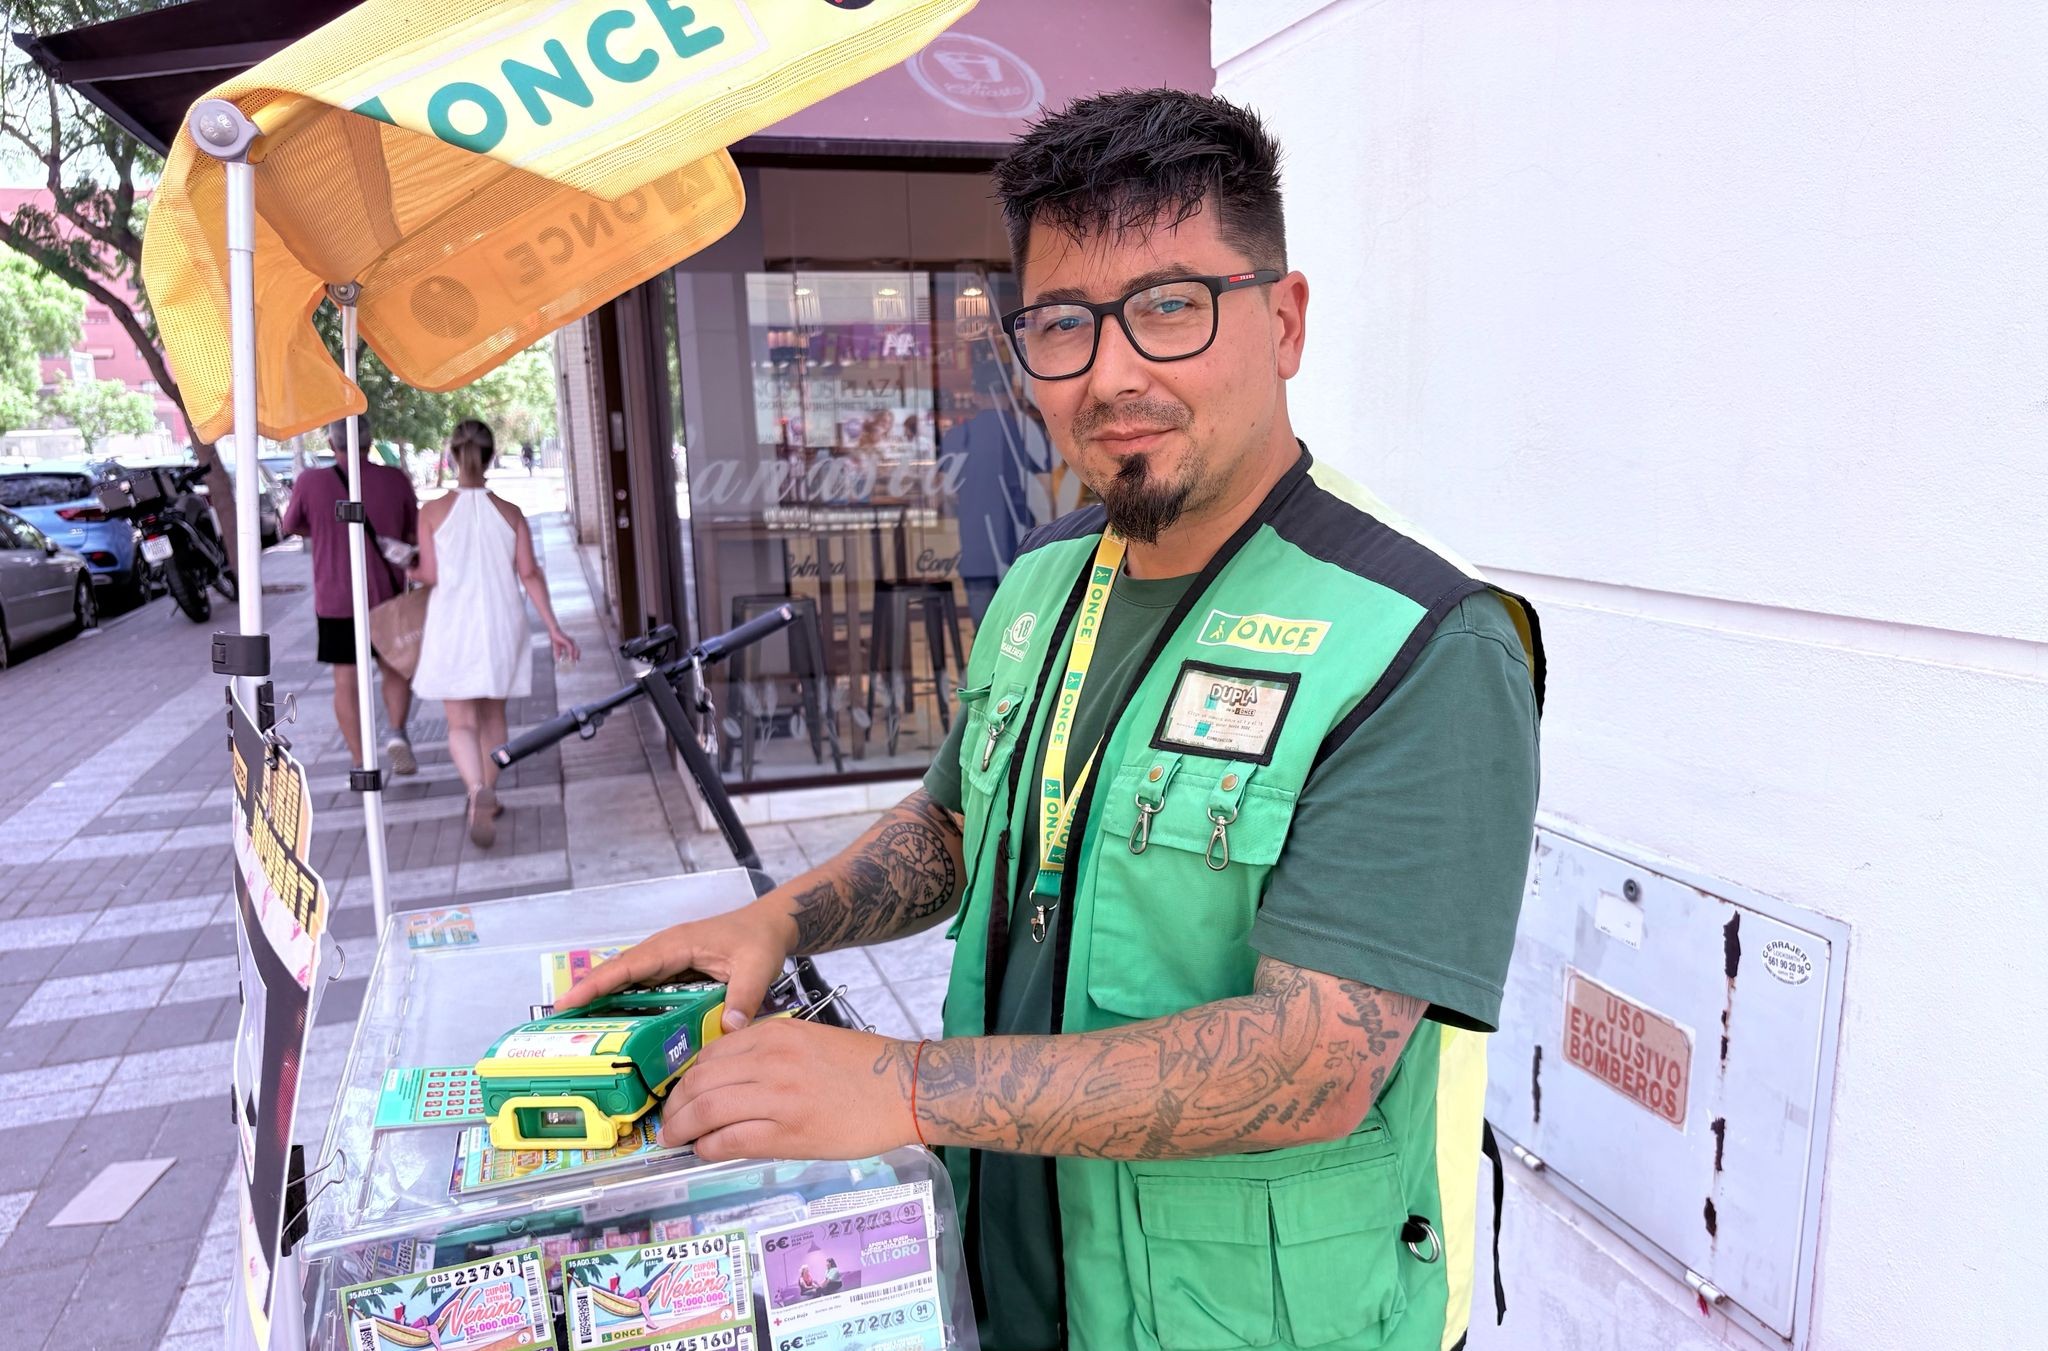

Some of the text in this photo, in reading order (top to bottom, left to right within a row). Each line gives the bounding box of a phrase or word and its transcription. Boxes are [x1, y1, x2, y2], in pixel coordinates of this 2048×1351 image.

[427, 0, 725, 153] ONCE
[1079, 588, 1103, 639] ONCE
[1237, 619, 1319, 647] ONCE
[1209, 684, 1257, 706] DUPLA
[1053, 694, 1073, 744] ONCE
[1046, 802, 1059, 849] ONC
[1762, 941, 1811, 971] CERRAJERO
[1606, 997, 1645, 1039] USO
[507, 1047, 545, 1058] Getnet
[1570, 1005, 1681, 1089] EXCLUSIVO
[1570, 1033, 1676, 1118] BOMBEROS
[903, 1203, 916, 1217] 93
[765, 1210, 892, 1252] 6€ 27273
[644, 1238, 724, 1260] 013 45160
[892, 1243, 920, 1260] ORO
[430, 1258, 517, 1287] 083 23761
[693, 1258, 717, 1273] CUPÓN
[484, 1282, 512, 1297] CUPÓN
[652, 1264, 729, 1308] Verano
[441, 1287, 525, 1336] Verano
[916, 1303, 928, 1315] 94
[614, 1328, 643, 1340] ONCE
[676, 1333, 733, 1351] 45160
[780, 1309, 905, 1351] 6€ 27273
